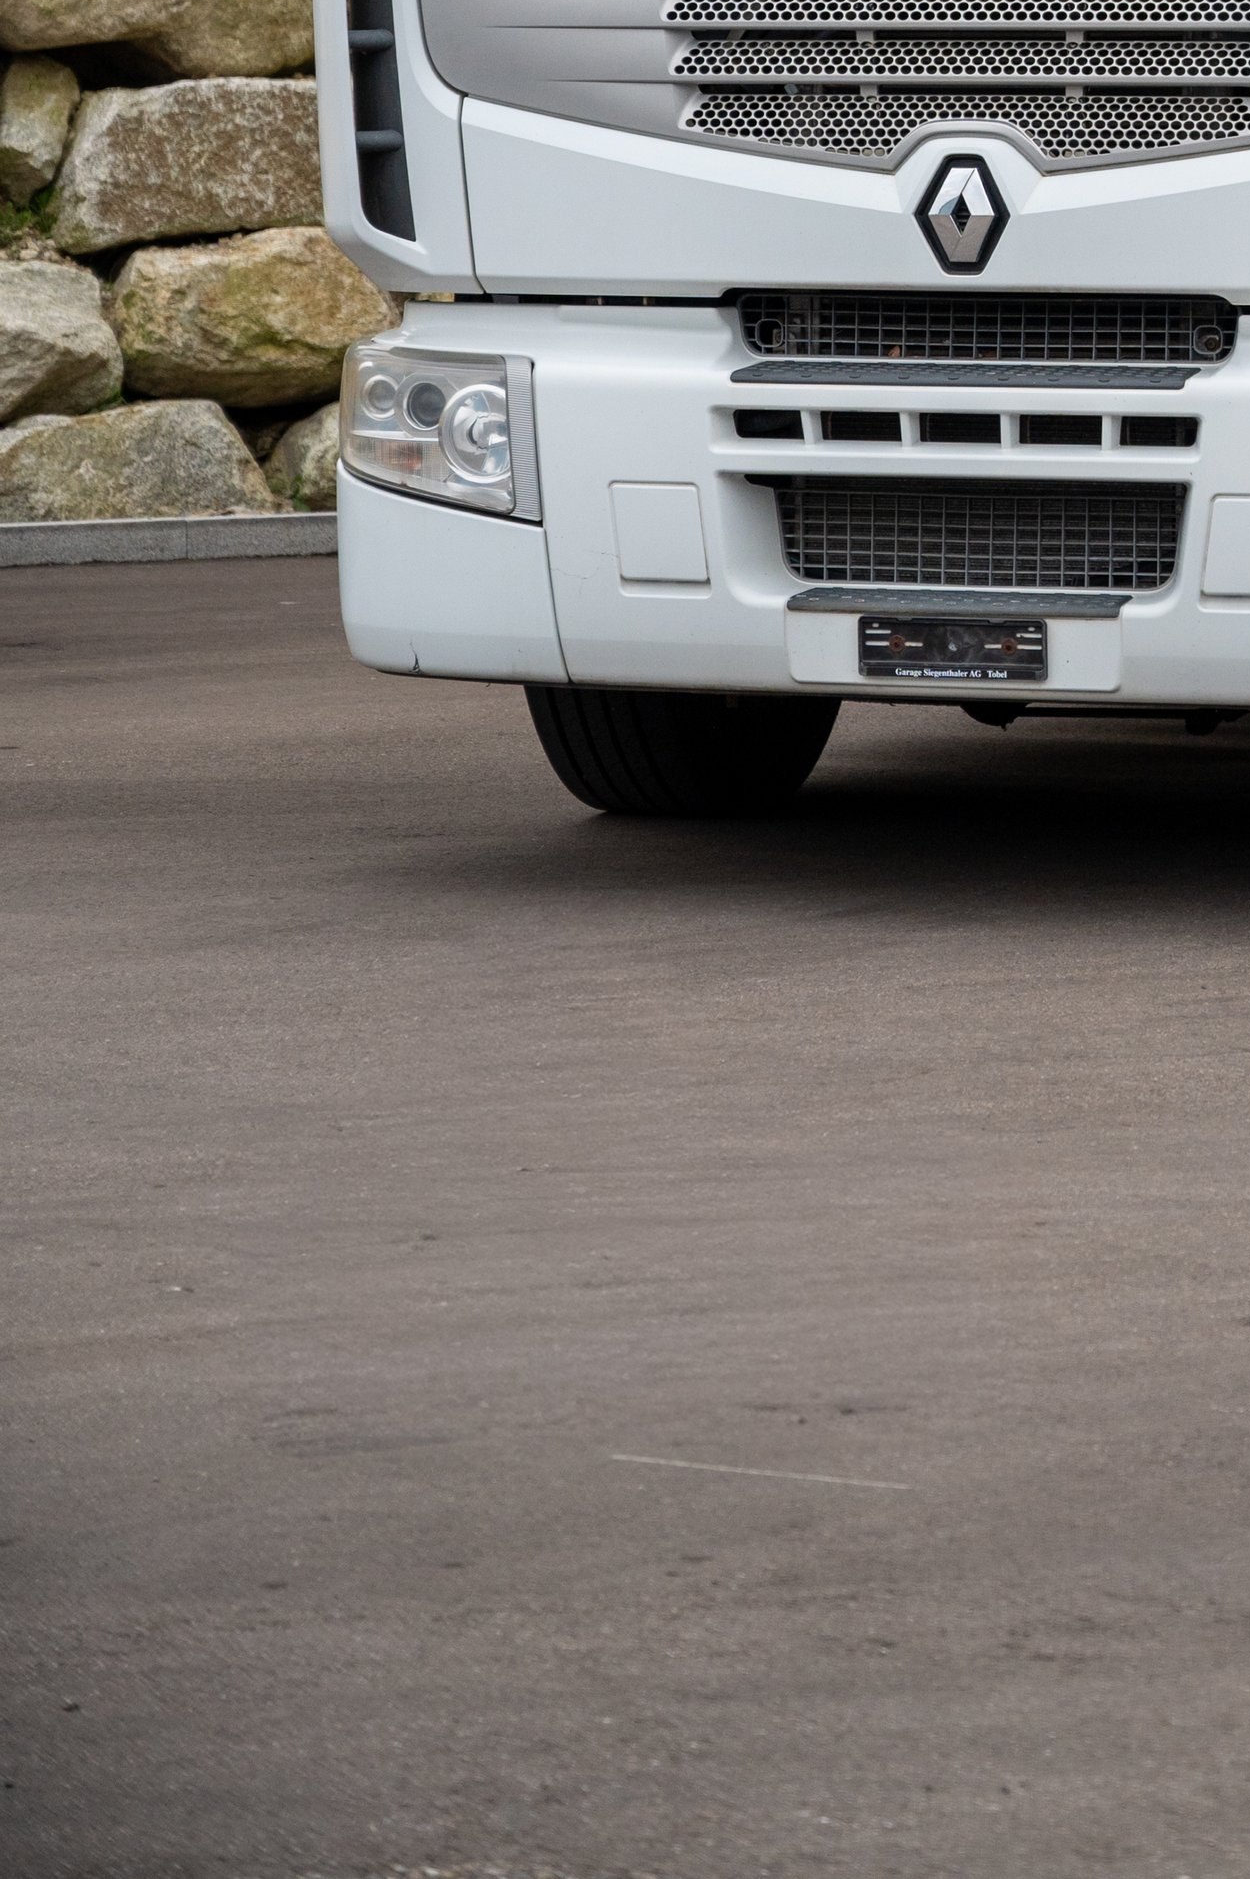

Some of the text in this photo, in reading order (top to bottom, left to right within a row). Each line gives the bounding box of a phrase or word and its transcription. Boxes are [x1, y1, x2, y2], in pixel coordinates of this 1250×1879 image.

[895, 668, 1007, 678] Garage Siegenthaler AG Tobel
